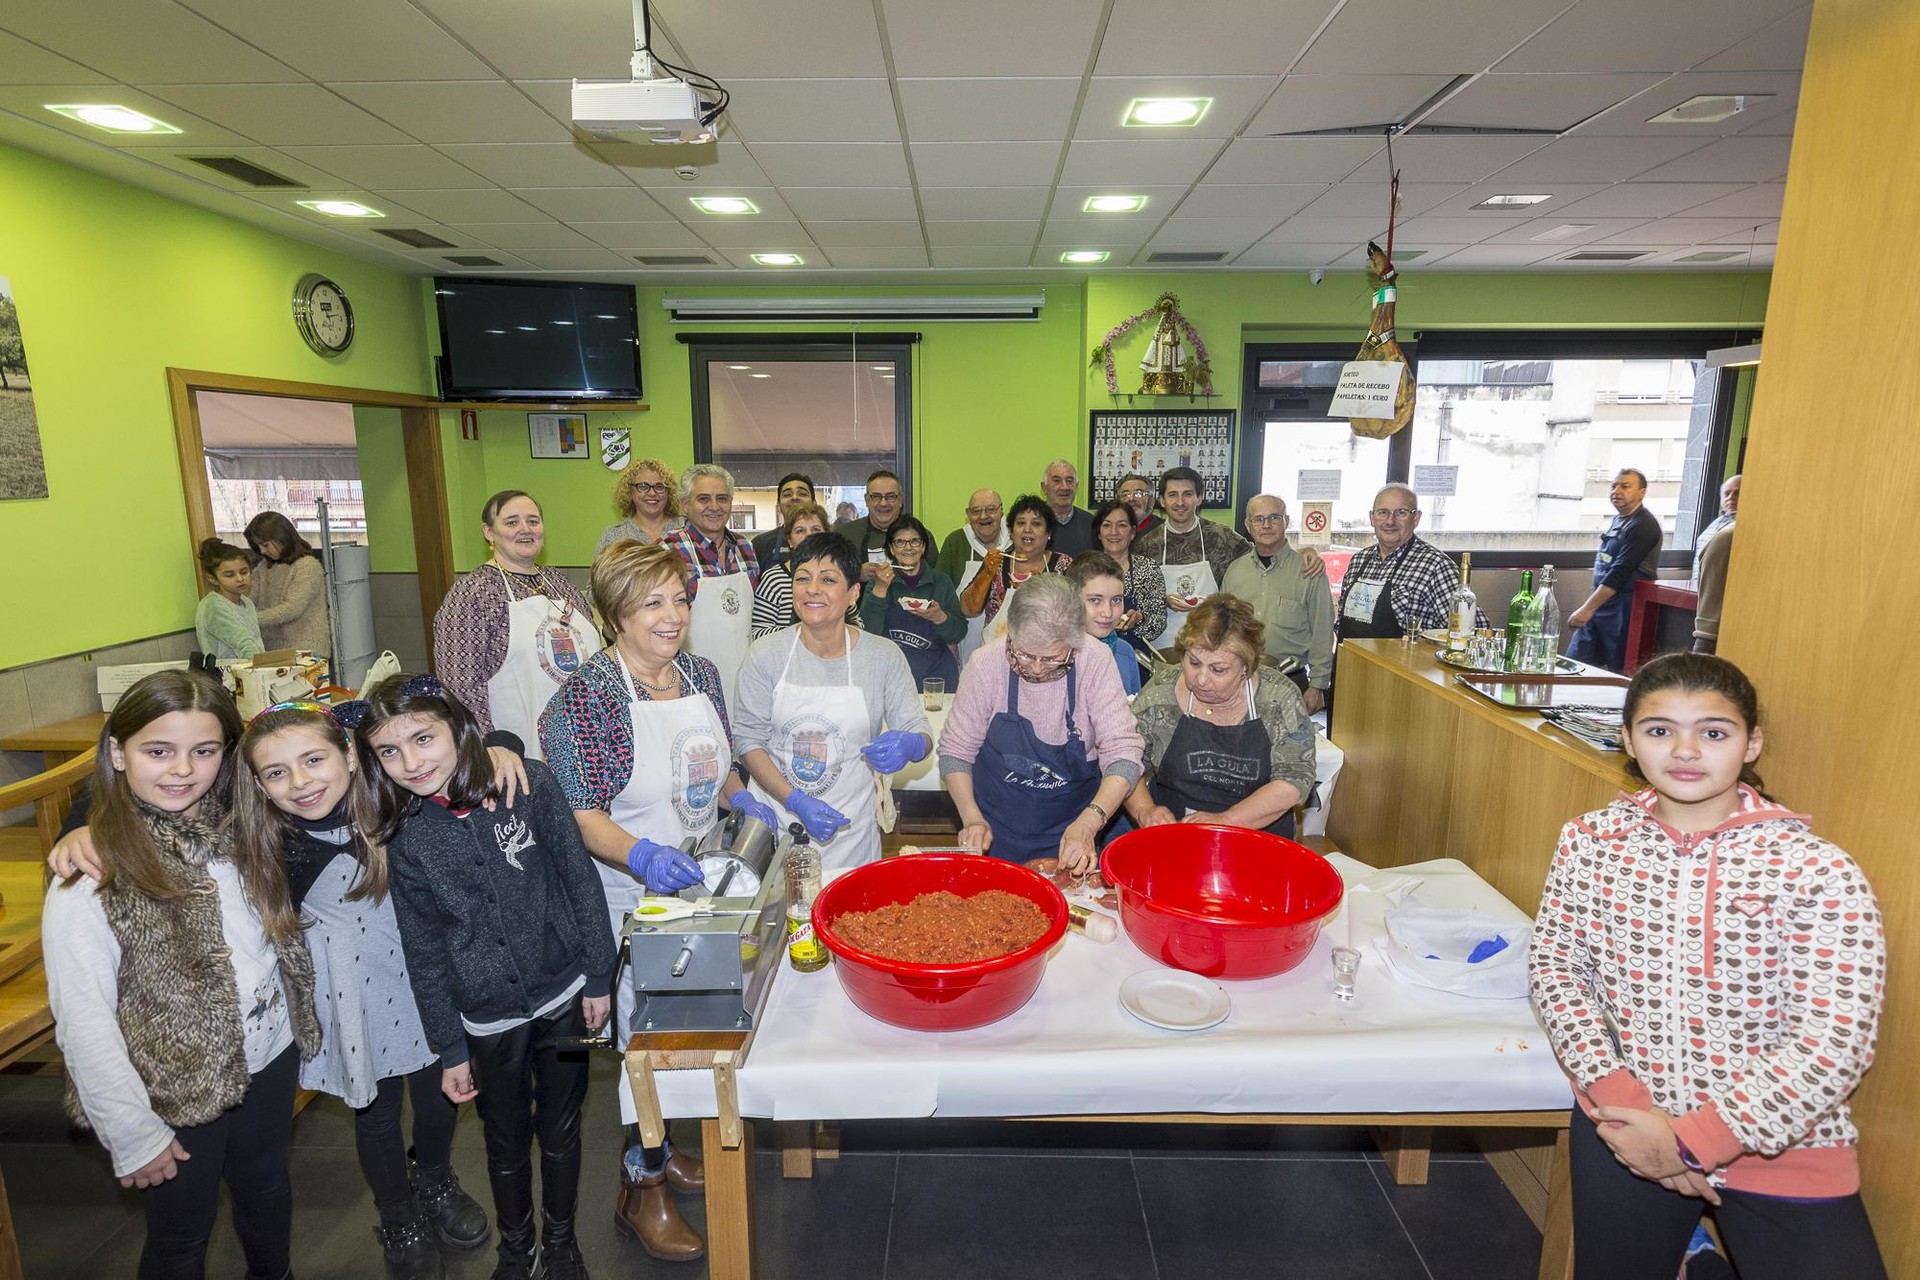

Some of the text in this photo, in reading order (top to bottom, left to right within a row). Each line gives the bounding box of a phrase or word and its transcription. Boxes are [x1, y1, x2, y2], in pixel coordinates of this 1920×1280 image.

[894, 632, 926, 648] LA GULA
[1197, 757, 1250, 774] LA GULA
[1203, 774, 1217, 782] DEL
